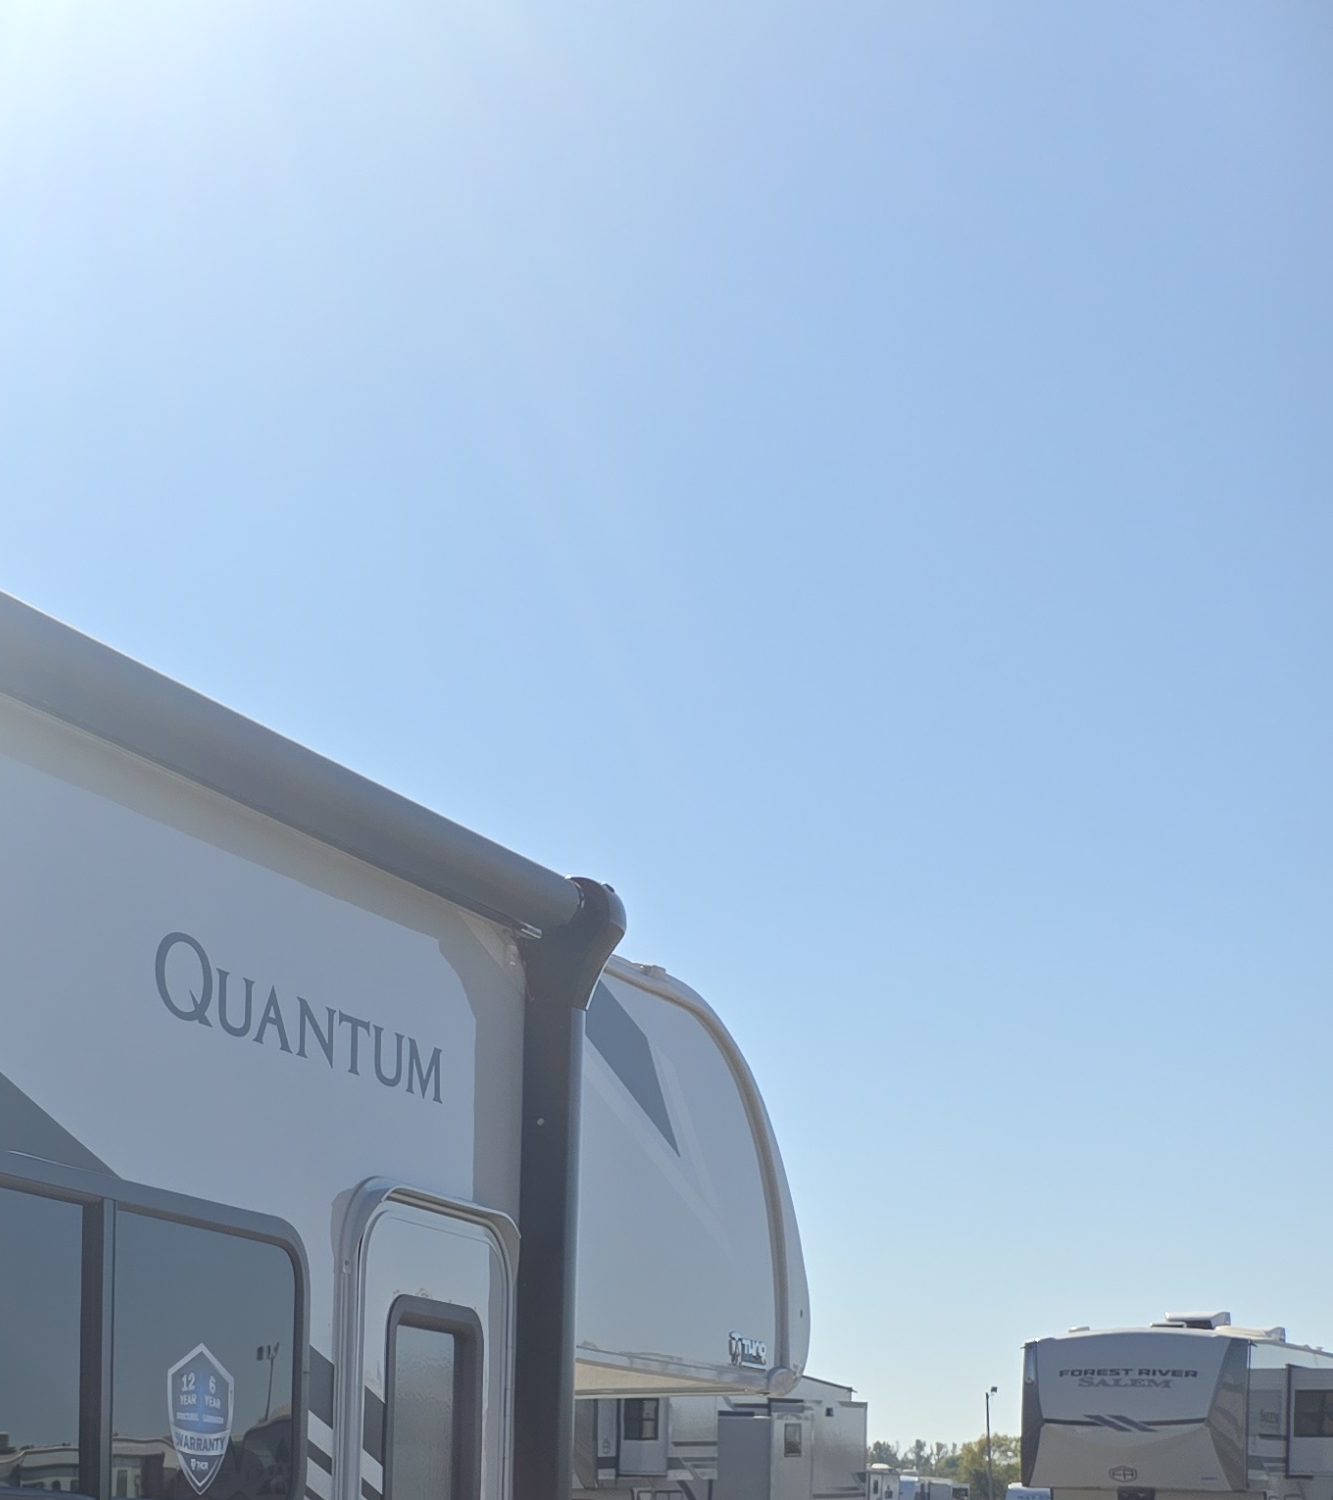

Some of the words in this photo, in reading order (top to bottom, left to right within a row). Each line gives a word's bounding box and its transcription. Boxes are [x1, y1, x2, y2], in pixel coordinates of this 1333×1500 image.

[154, 931, 443, 1104] QUANTUM
[1059, 1368, 1133, 1378] FOREST
[1137, 1368, 1198, 1378] RIVER
[181, 1372, 196, 1392] 12
[208, 1376, 216, 1394] 6
[1077, 1377, 1173, 1389] SALEM
[180, 1394, 197, 1406] YEAR
[204, 1394, 222, 1409] YEAR
[174, 1431, 226, 1452] WARRANTY
